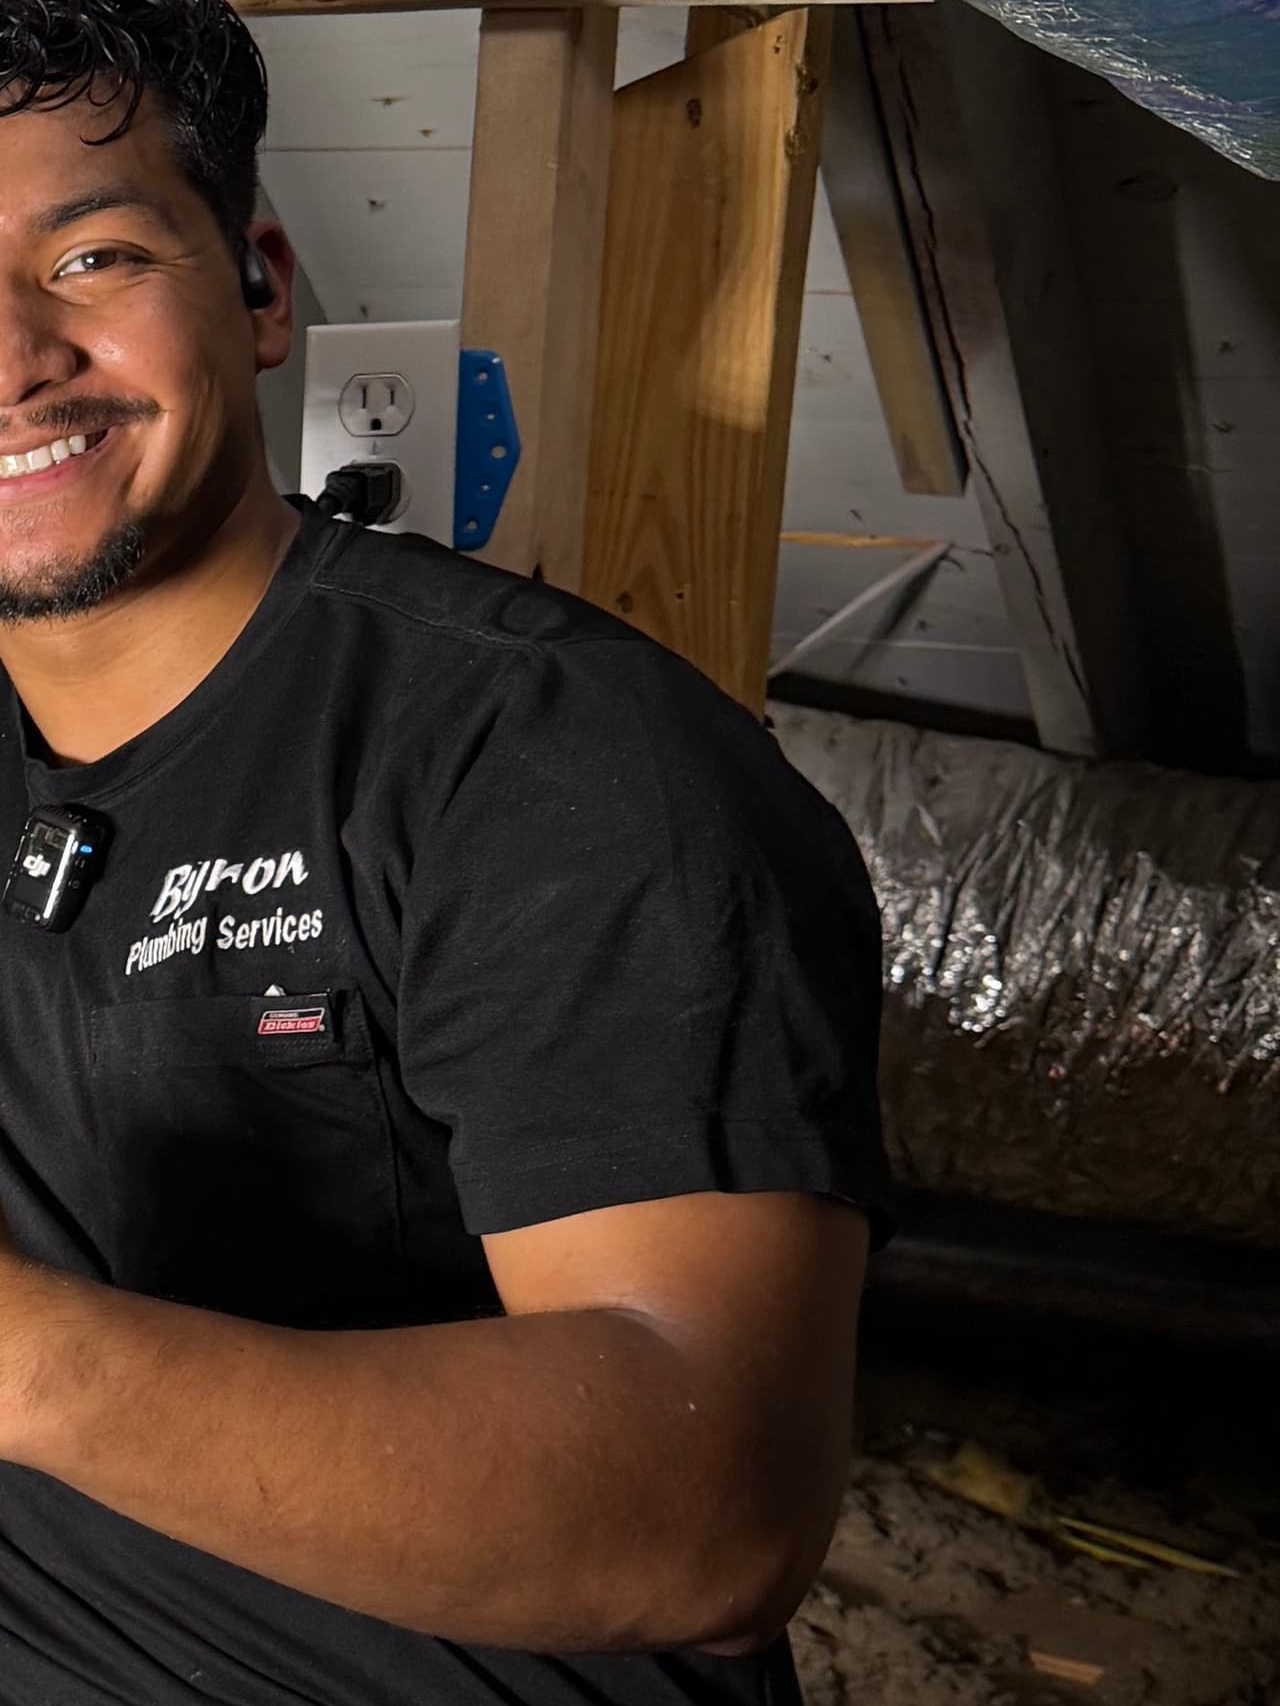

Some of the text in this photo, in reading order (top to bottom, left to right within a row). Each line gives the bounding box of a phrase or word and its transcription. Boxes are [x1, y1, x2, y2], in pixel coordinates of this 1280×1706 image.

[149, 850, 310, 925] Byron
[124, 906, 324, 976] Plumbing Services
